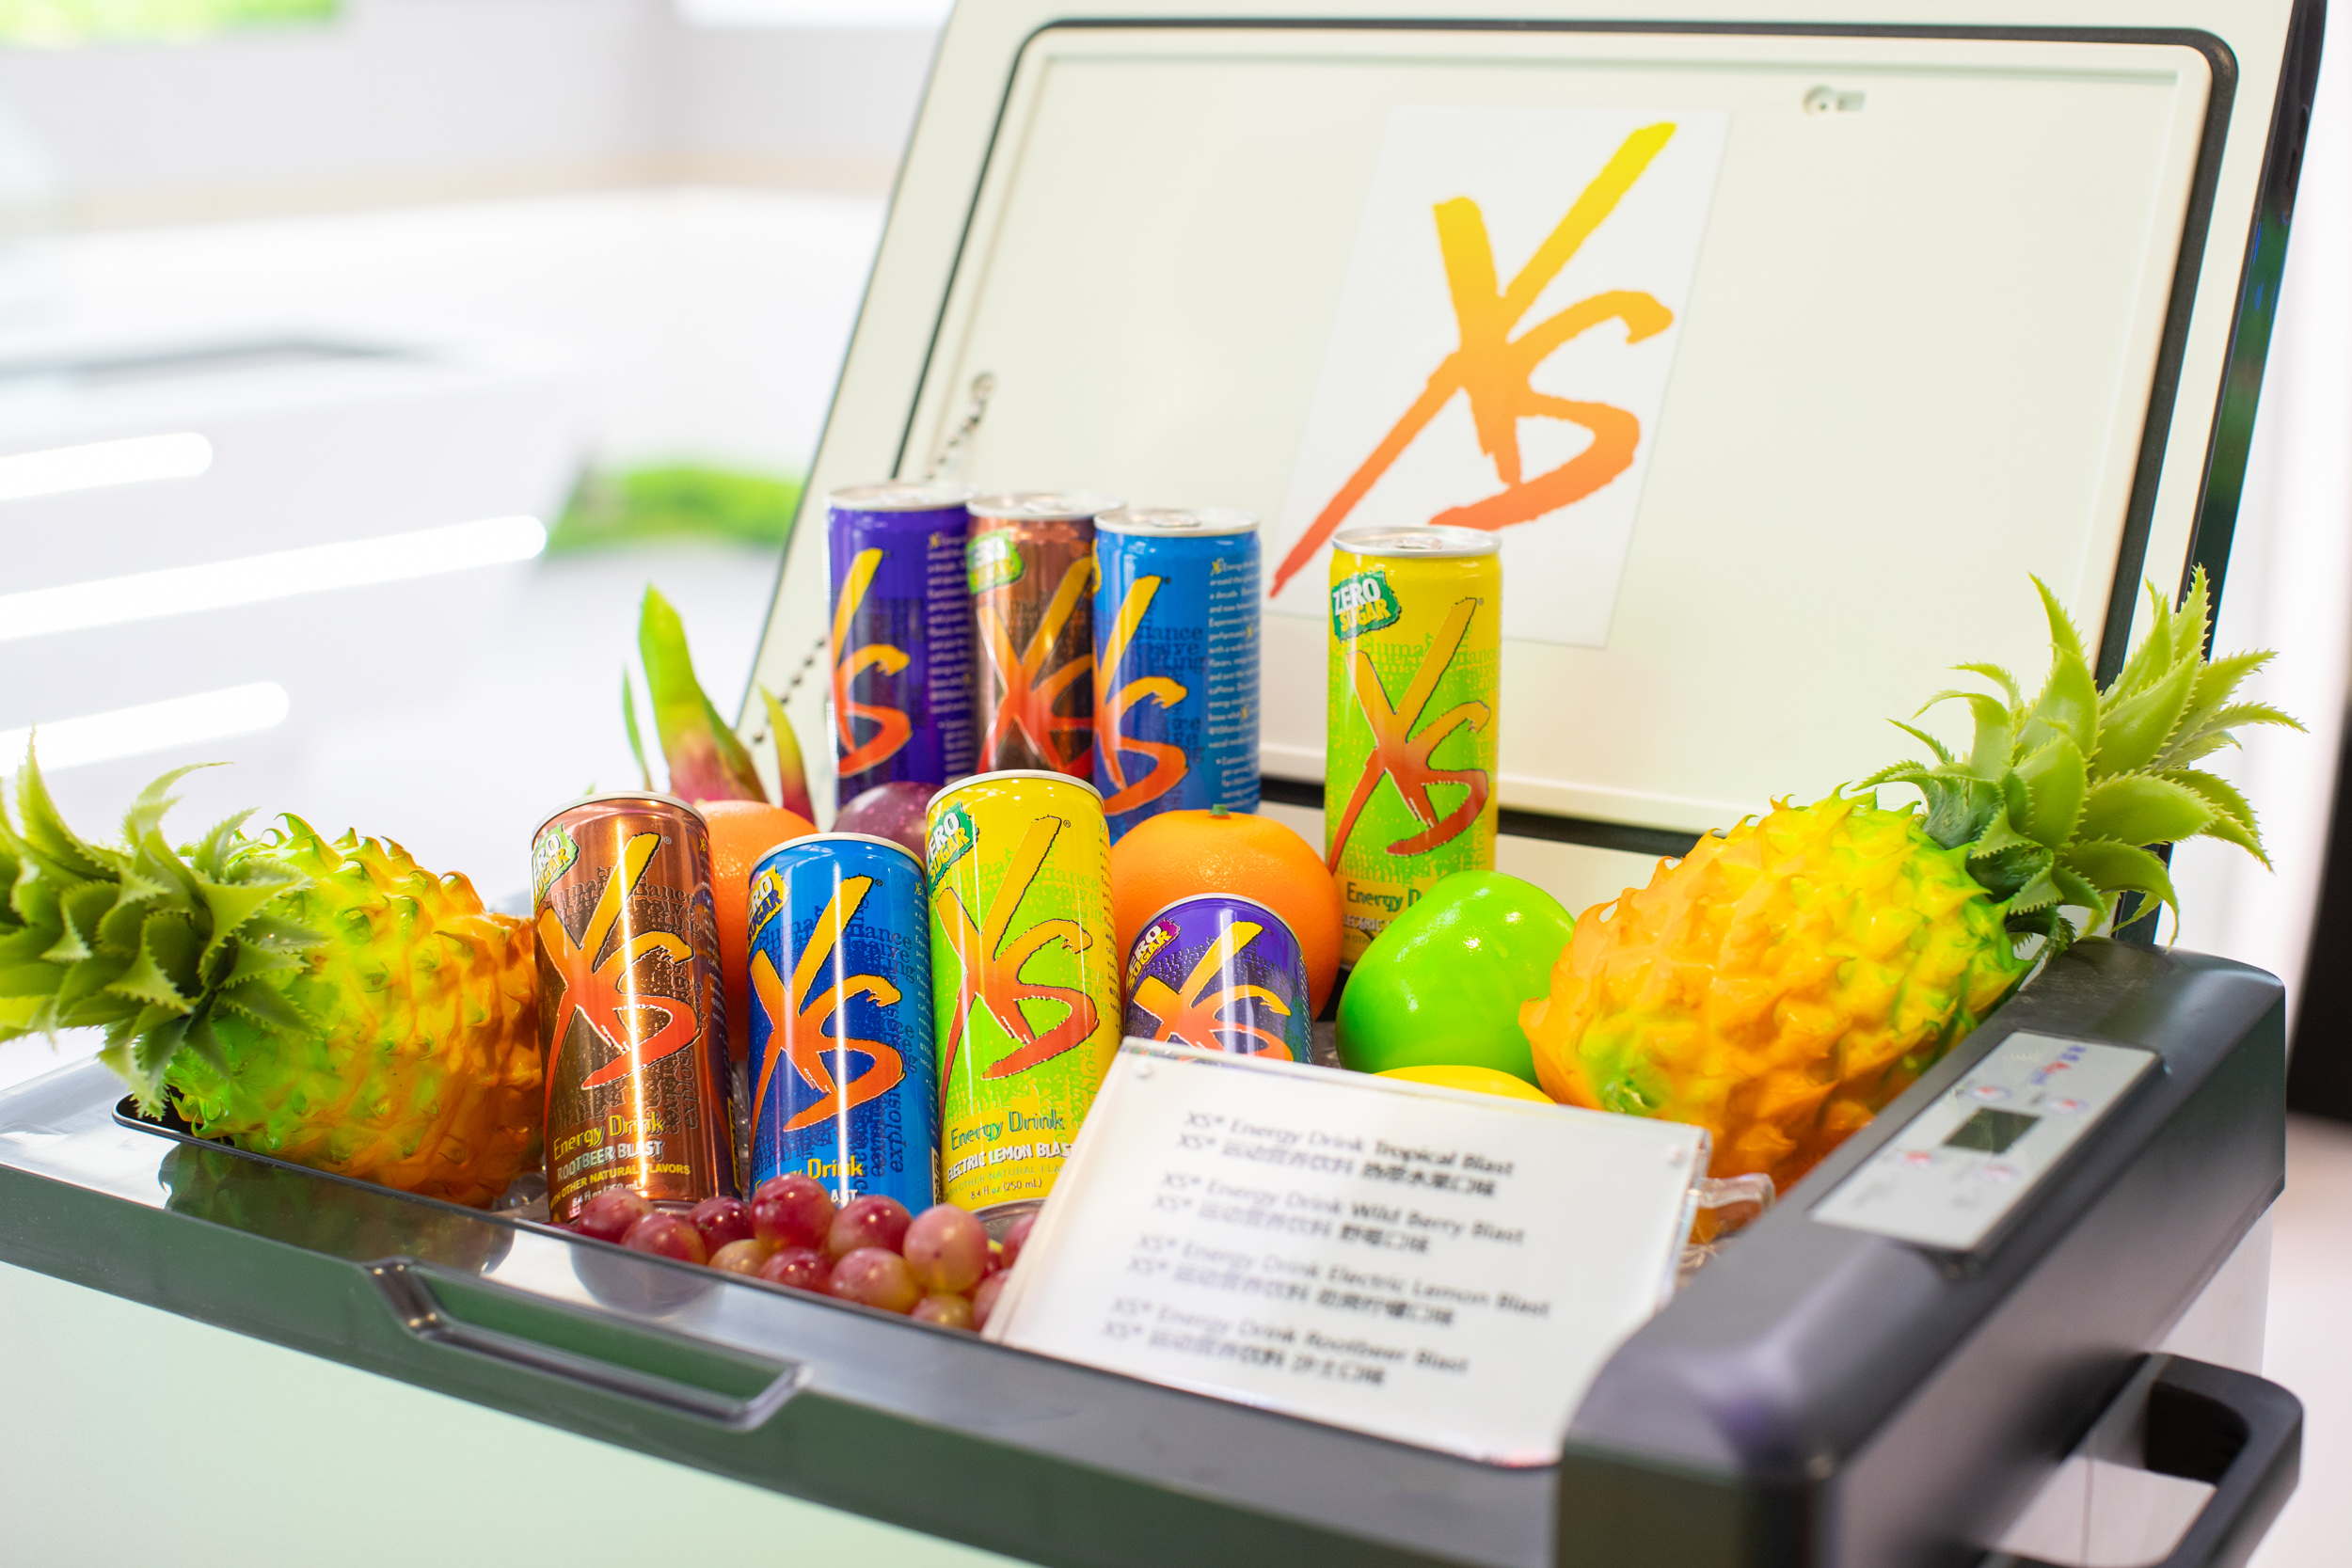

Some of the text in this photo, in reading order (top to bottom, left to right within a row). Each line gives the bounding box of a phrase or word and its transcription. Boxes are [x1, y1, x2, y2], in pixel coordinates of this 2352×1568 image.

[1332, 578, 1382, 616] ZERO
[1339, 598, 1391, 632] SUGAR
[930, 827, 971, 884] SUGAR
[1346, 881, 1403, 912] Energy
[1128, 930, 1172, 990] SUGAR
[553, 1112, 664, 1162] Energy Drink
[950, 1108, 1064, 1151] Energy Drink
[1230, 1117, 1303, 1145] Energy
[1309, 1130, 1364, 1152] Drink
[1375, 1137, 1459, 1166] Tropical
[1461, 1151, 1516, 1176] Blast
[557, 1139, 664, 1182] ROOTBEER BLAST
[562, 1177, 588, 1197] OTHER
[589, 1164, 640, 1184] NATURAL
[644, 1163, 691, 1175] FLAVORS
[808, 1155, 864, 1180] Drink
[947, 1141, 1072, 1183] ELECTRIC LEMON BLAS
[959, 1174, 985, 1192] OTHER
[988, 1164, 1036, 1180] NATURAL
[970, 1189, 981, 1200] 8.4
[1002, 1180, 1022, 1192] (250
[1205, 1179, 1280, 1207] Energy
[1285, 1190, 1342, 1213] Drink
[1352, 1199, 1402, 1224] Wild
[1406, 1211, 1466, 1239] Berry
[1470, 1221, 1526, 1245] Blast
[1182, 1239, 1257, 1270] Energy
[1262, 1252, 1320, 1279] Drink
[1327, 1263, 1405, 1291] Electric
[1412, 1276, 1489, 1306] Lemon
[1496, 1291, 1552, 1319] Blast
[1238, 1316, 1296, 1344] Drink
[1416, 1347, 1470, 1374] Blast
